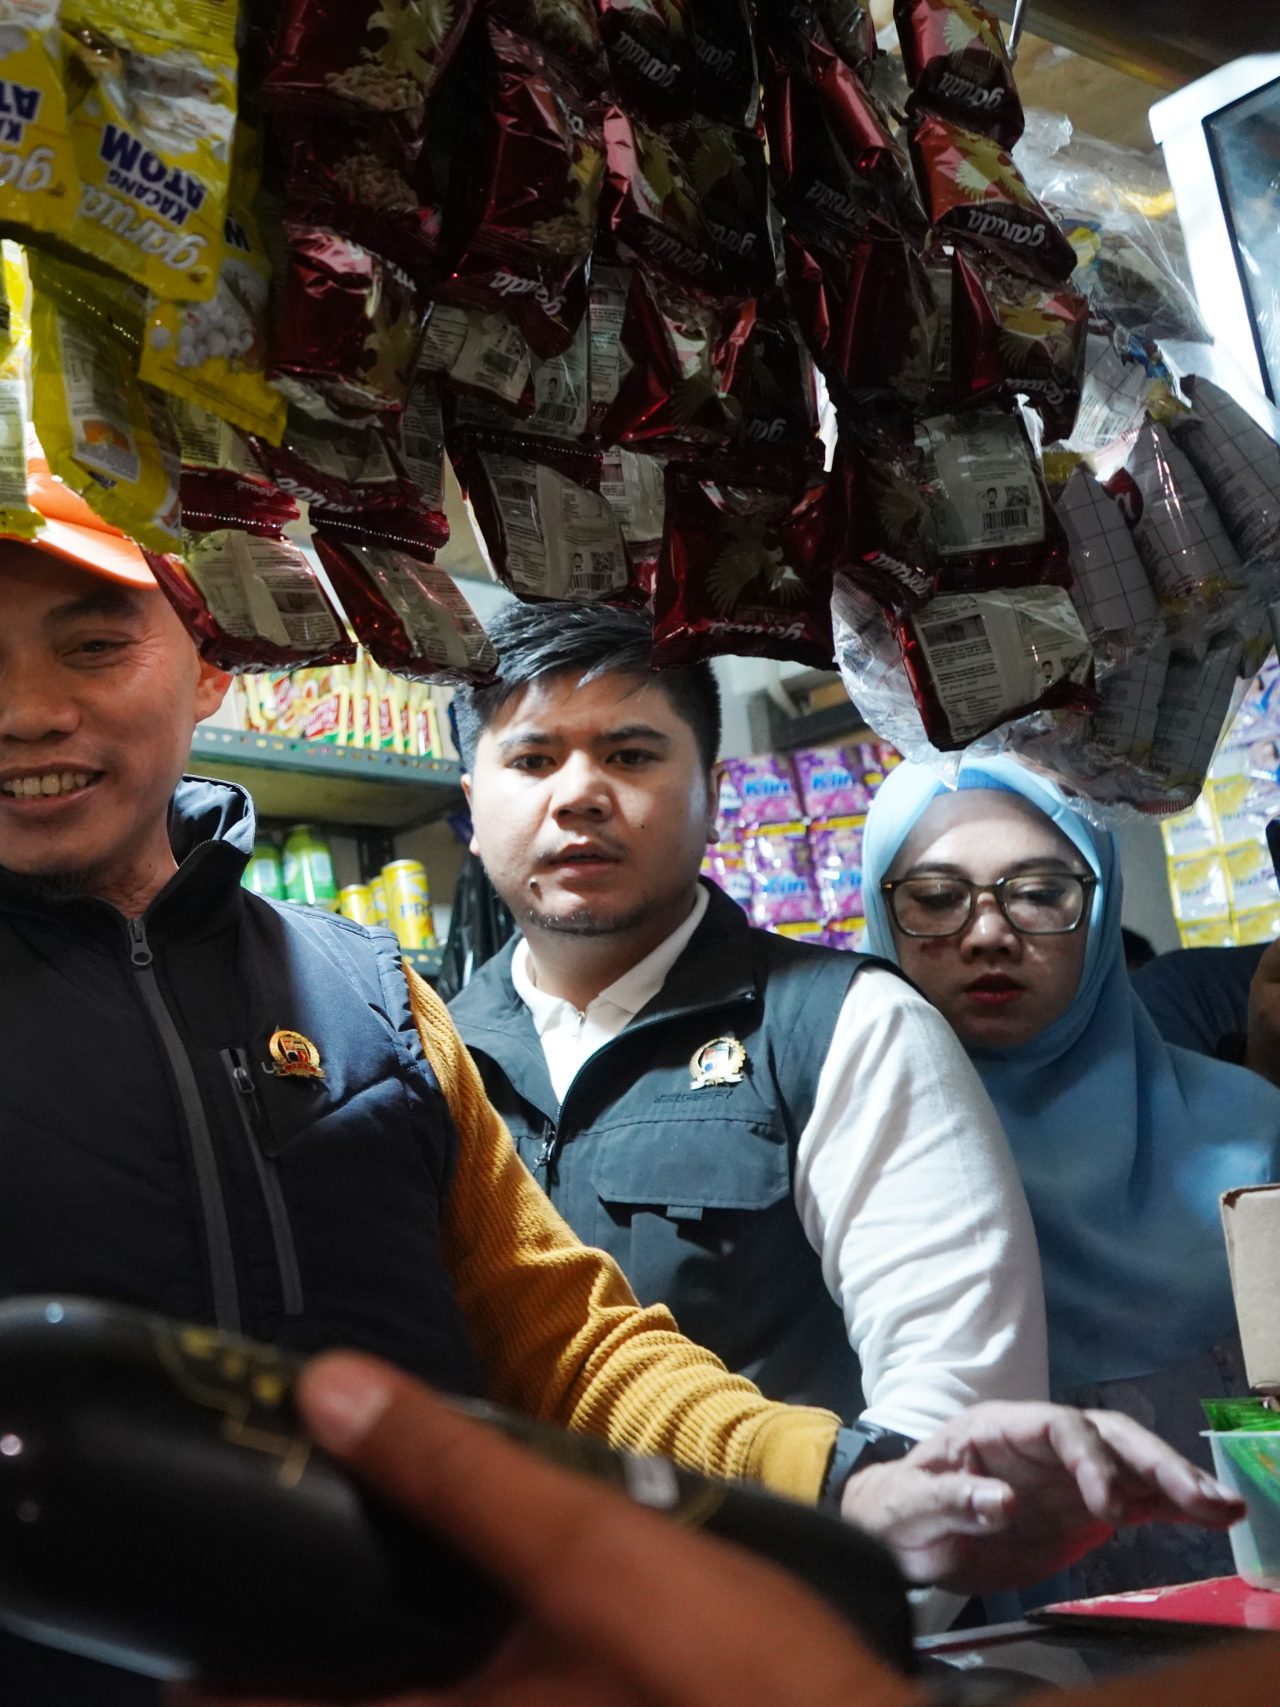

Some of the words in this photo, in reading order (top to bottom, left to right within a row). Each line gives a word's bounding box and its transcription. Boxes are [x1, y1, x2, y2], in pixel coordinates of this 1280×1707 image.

[99, 124, 206, 211] ATOM
[106, 168, 190, 226] KACANG
[967, 209, 1046, 246] garuda
